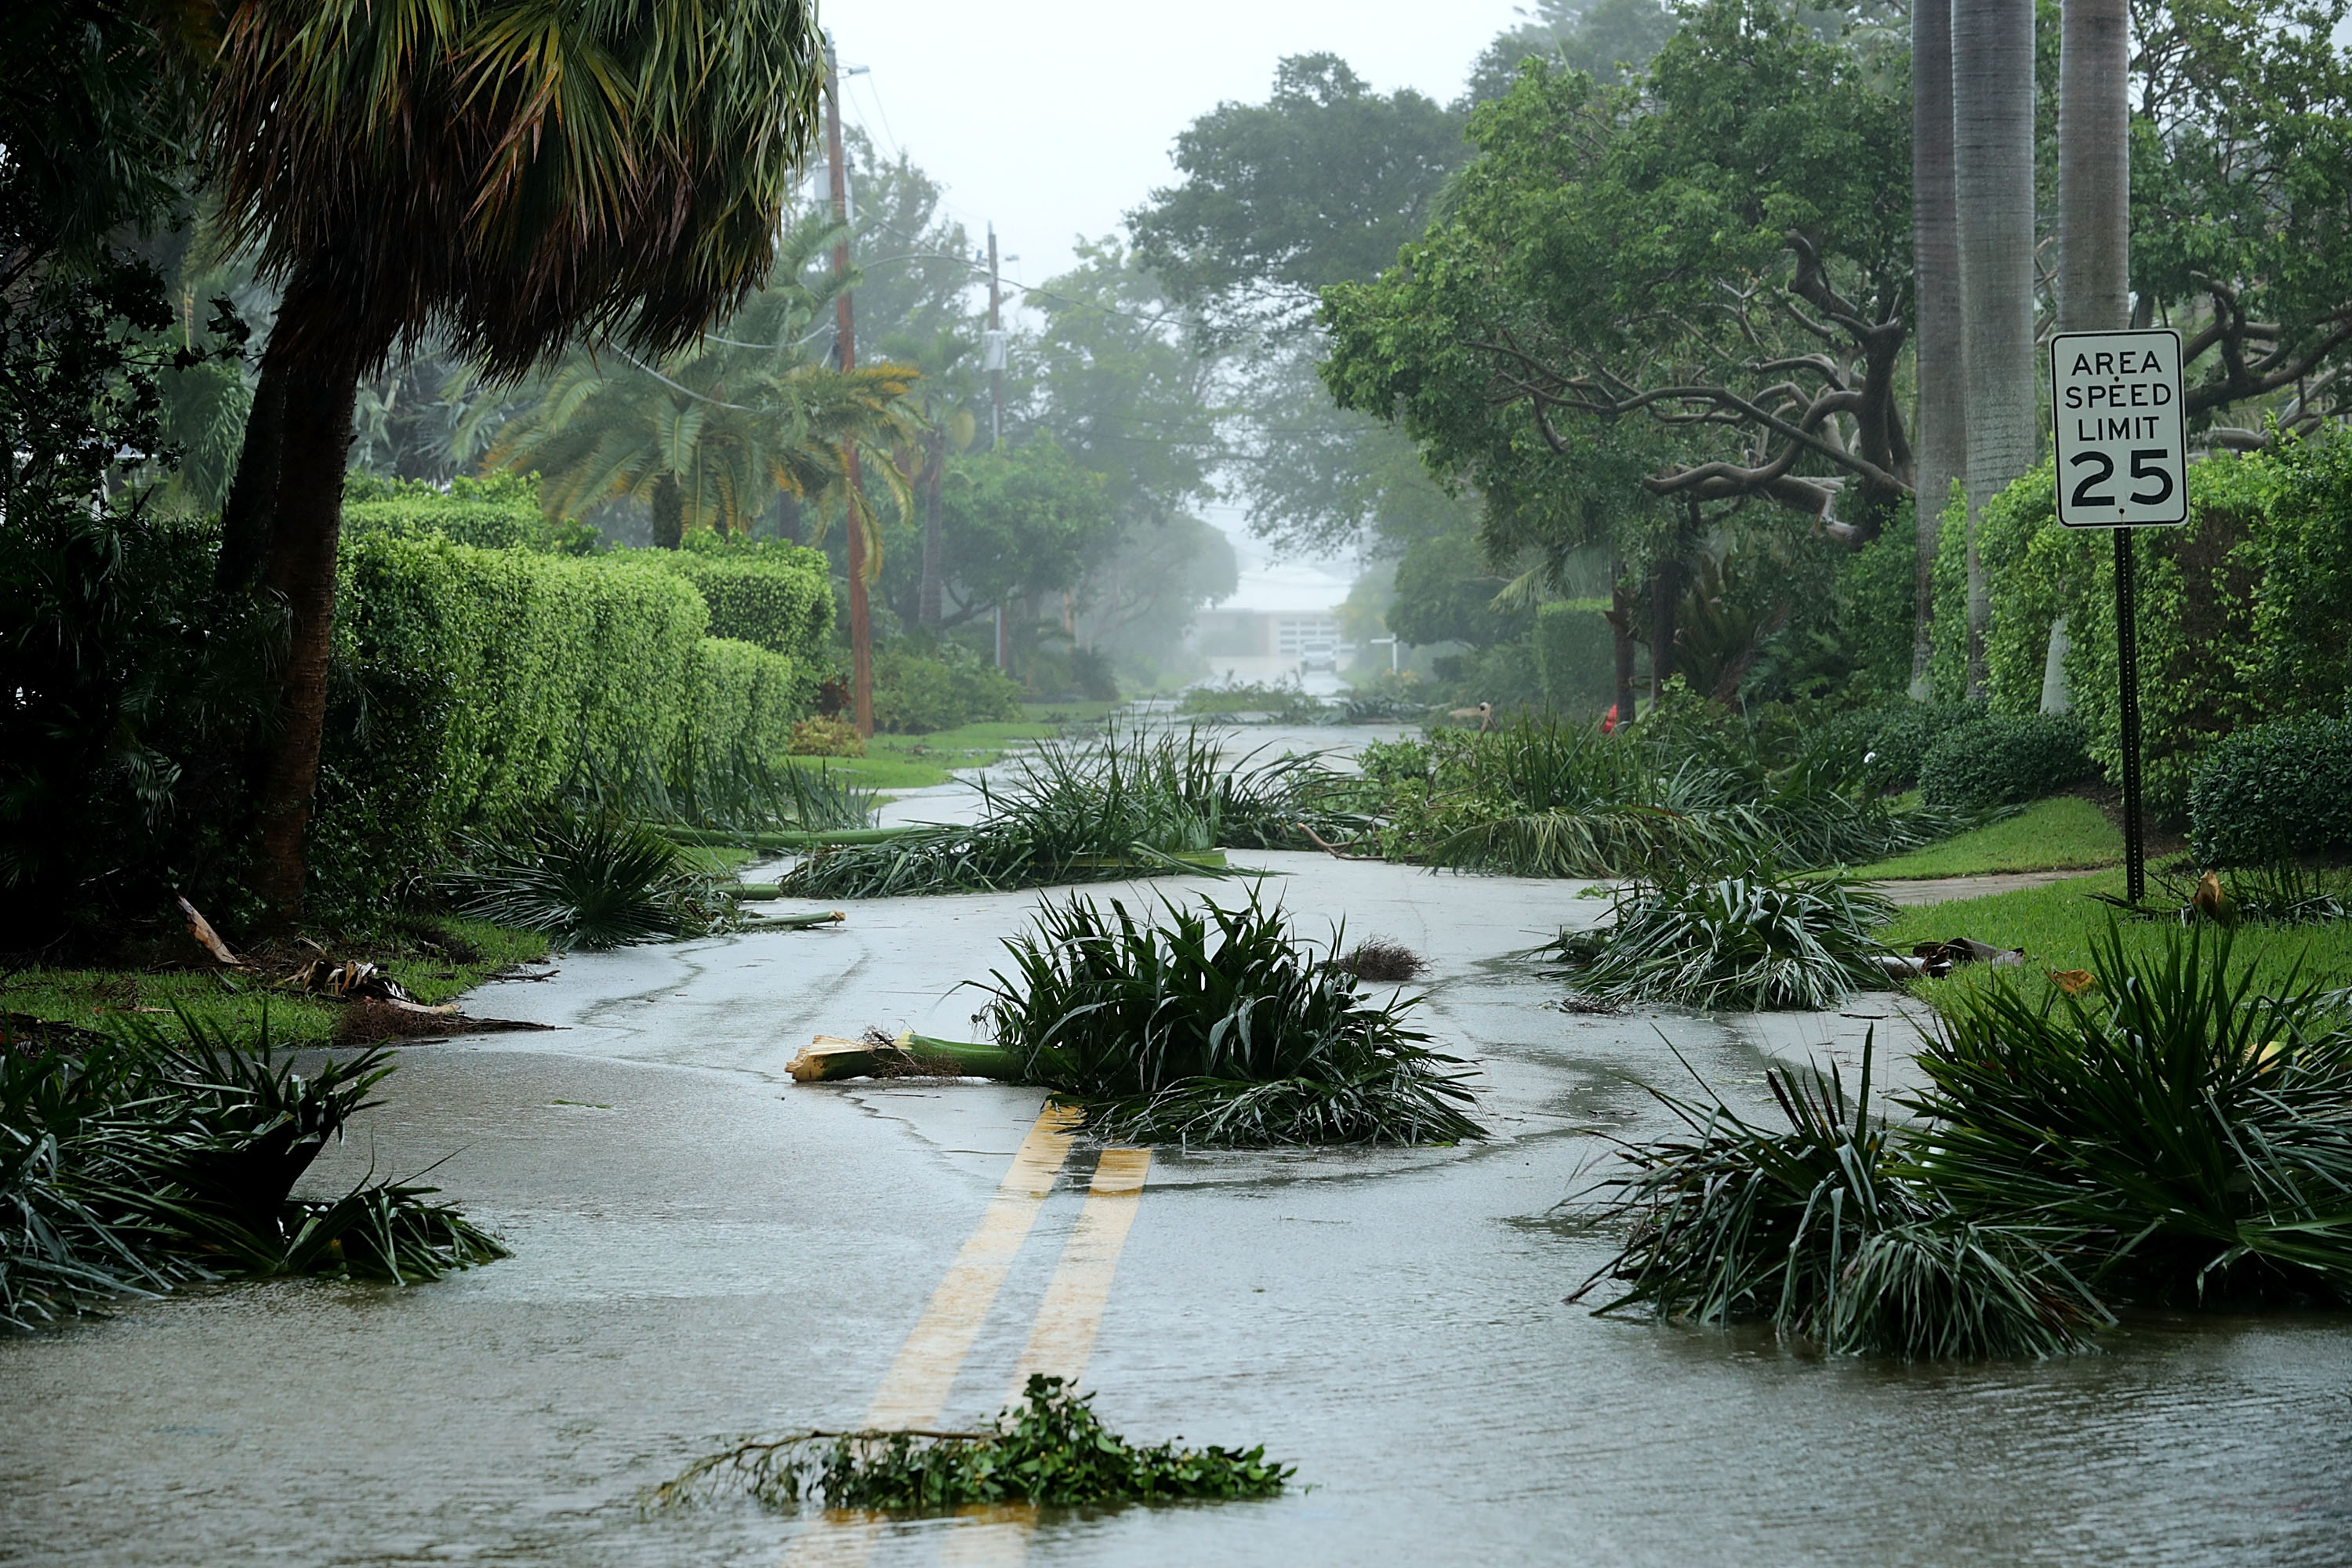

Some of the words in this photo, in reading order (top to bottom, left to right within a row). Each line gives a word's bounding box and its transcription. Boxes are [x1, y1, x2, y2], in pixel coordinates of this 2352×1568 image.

[2071, 350, 2162, 376] AREA
[2065, 383, 2172, 409] SPEED
[2078, 416, 2160, 441] LIMIT
[2070, 448, 2173, 507] 25
